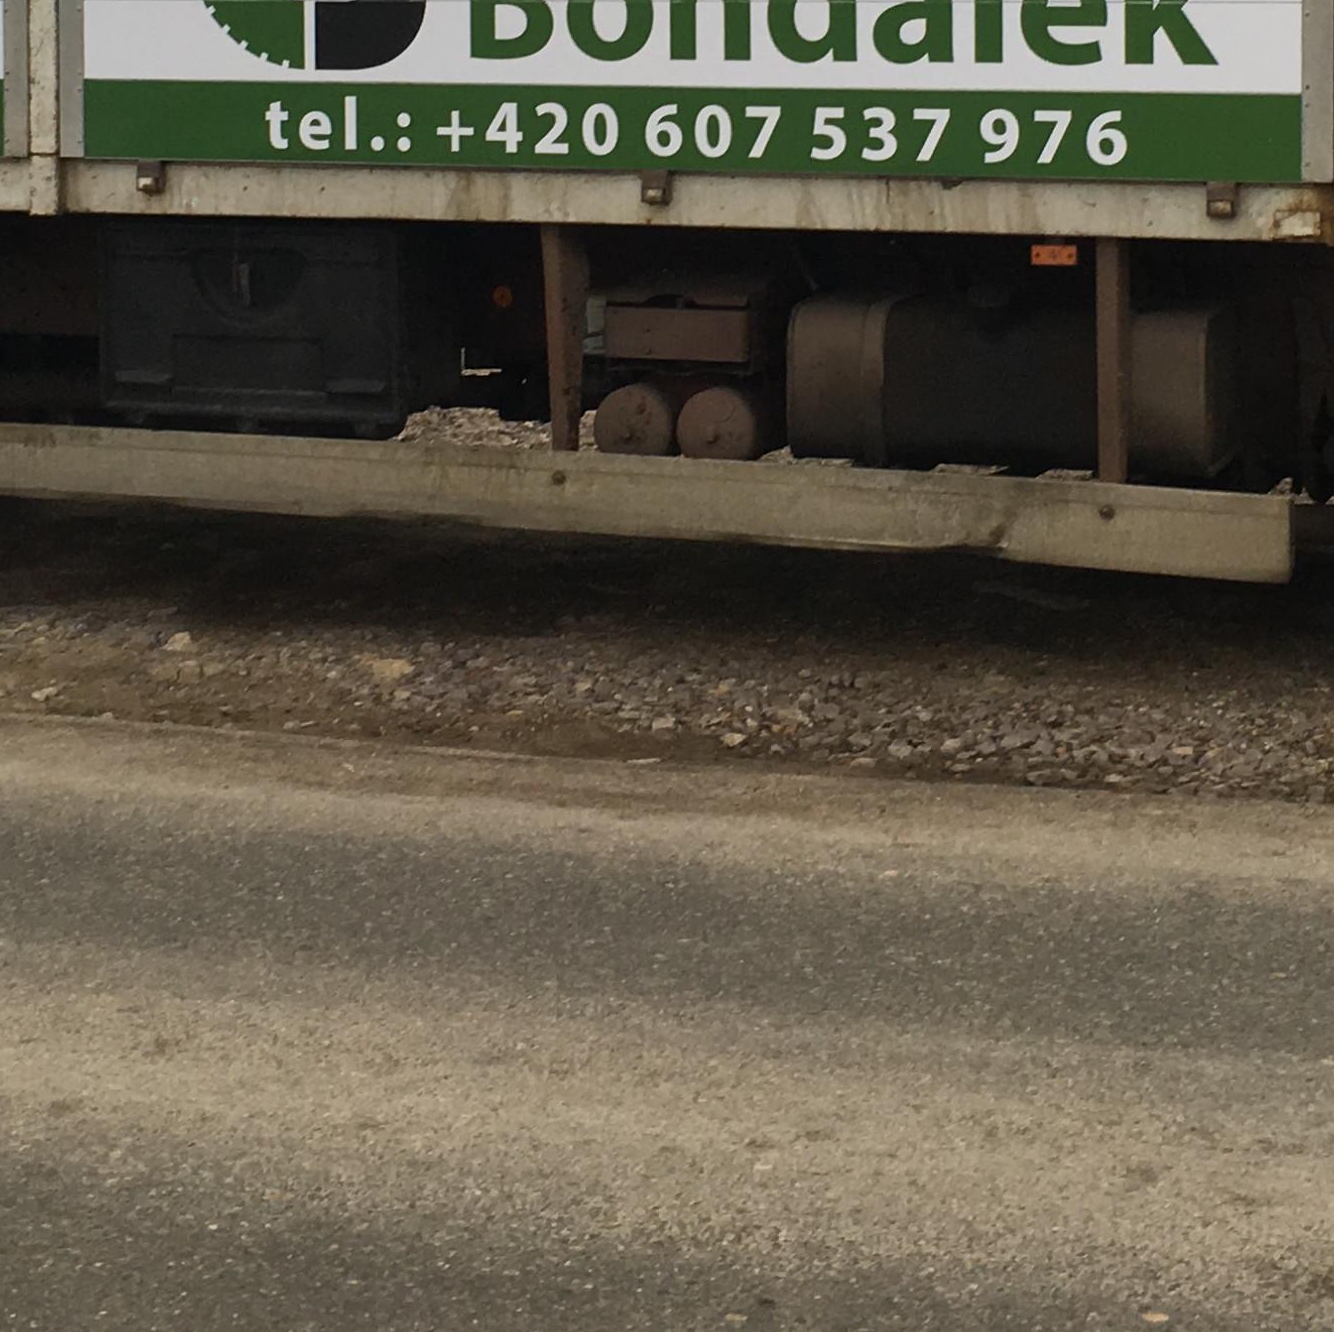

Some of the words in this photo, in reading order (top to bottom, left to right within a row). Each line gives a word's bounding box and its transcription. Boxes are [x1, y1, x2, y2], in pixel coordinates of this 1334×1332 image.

[265, 96, 410, 151] tel.:
[437, 103, 618, 155] +420
[646, 104, 781, 157] 607
[811, 107, 950, 161] 537
[980, 109, 1127, 165] 976
